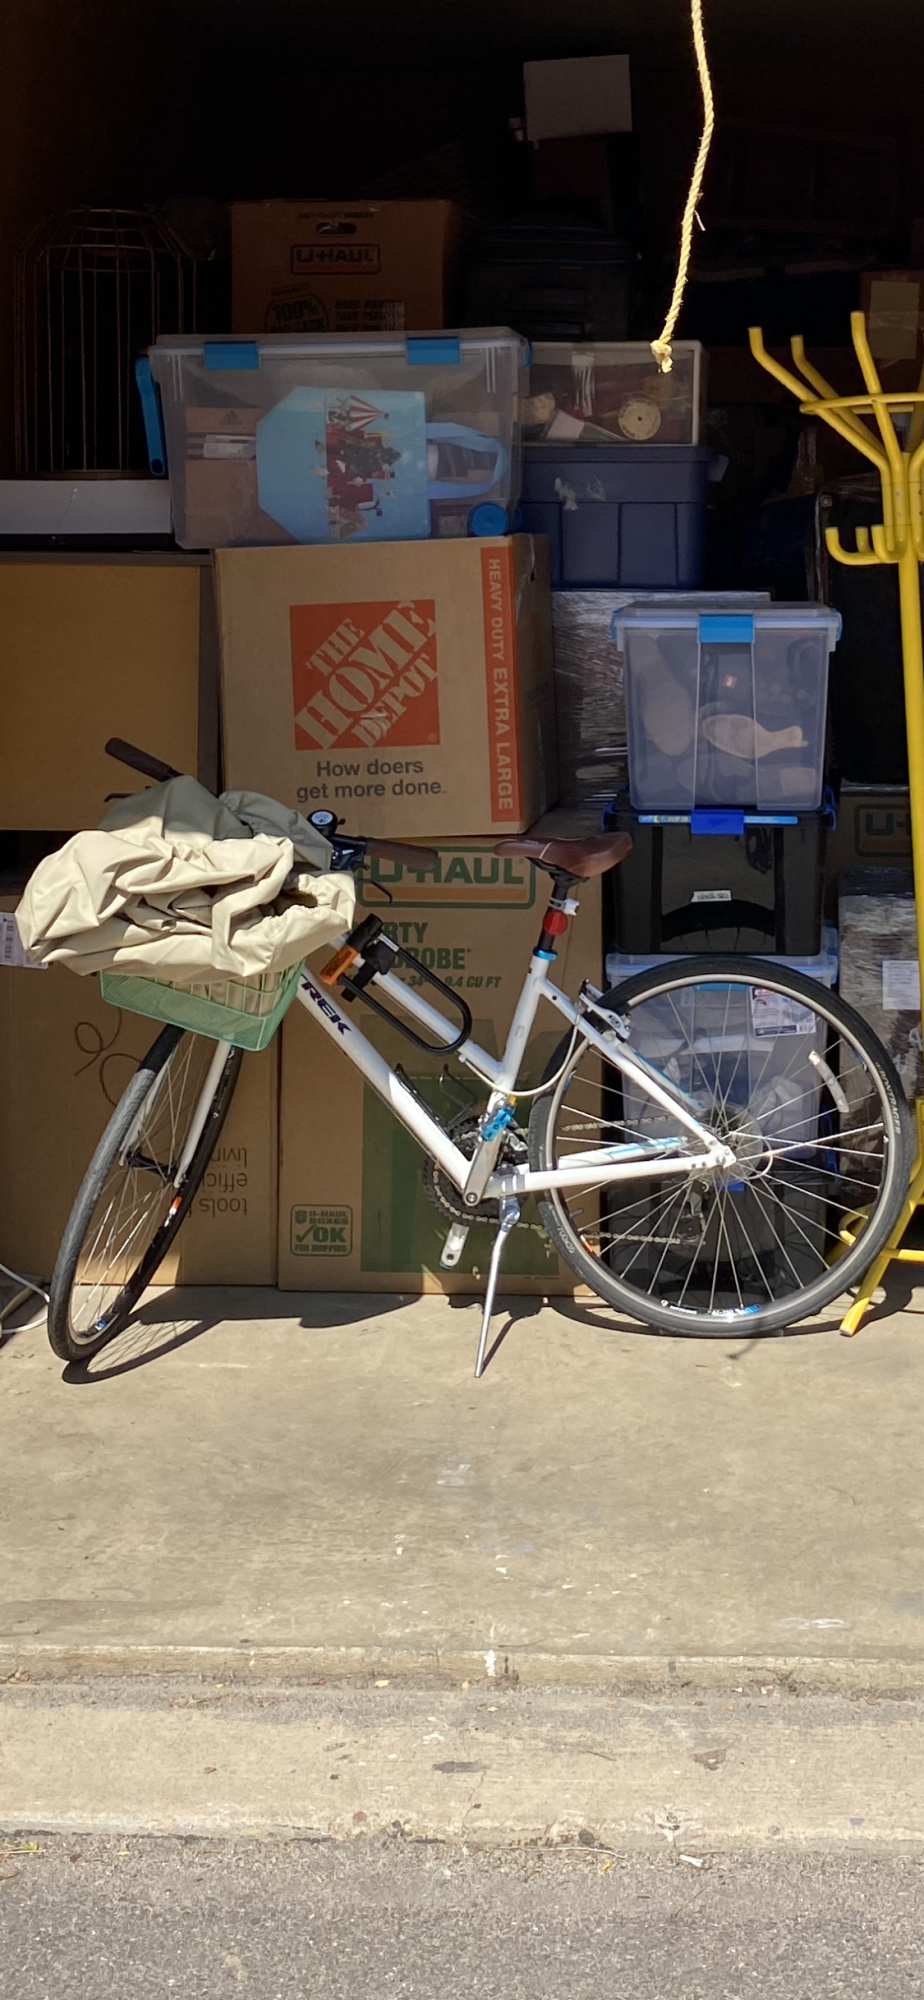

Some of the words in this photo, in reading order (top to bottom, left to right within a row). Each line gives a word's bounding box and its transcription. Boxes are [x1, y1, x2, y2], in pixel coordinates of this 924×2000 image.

[296, 248, 374, 262] U-HAUL
[272, 300, 318, 323] 100%
[488, 558, 504, 609] HEAVY
[305, 617, 366, 678] THE
[491, 617, 505, 661] DUTY
[294, 599, 437, 750] HOME
[351, 652, 438, 748] DEPOT
[493, 667, 511, 736] EXTRA
[316, 760, 360, 778] How
[366, 758, 424, 776] doers
[496, 741, 513, 810] LARGE
[296, 783, 329, 804] get
[335, 783, 386, 799] more
[384, 921, 429, 944] RTY
[466, 975, 483, 989] CU
[485, 976, 502, 989] FT
[199, 1197, 248, 1218] tools
[312, 1226, 347, 1243] OK
[311, 1244, 347, 1252] SHIPPING
